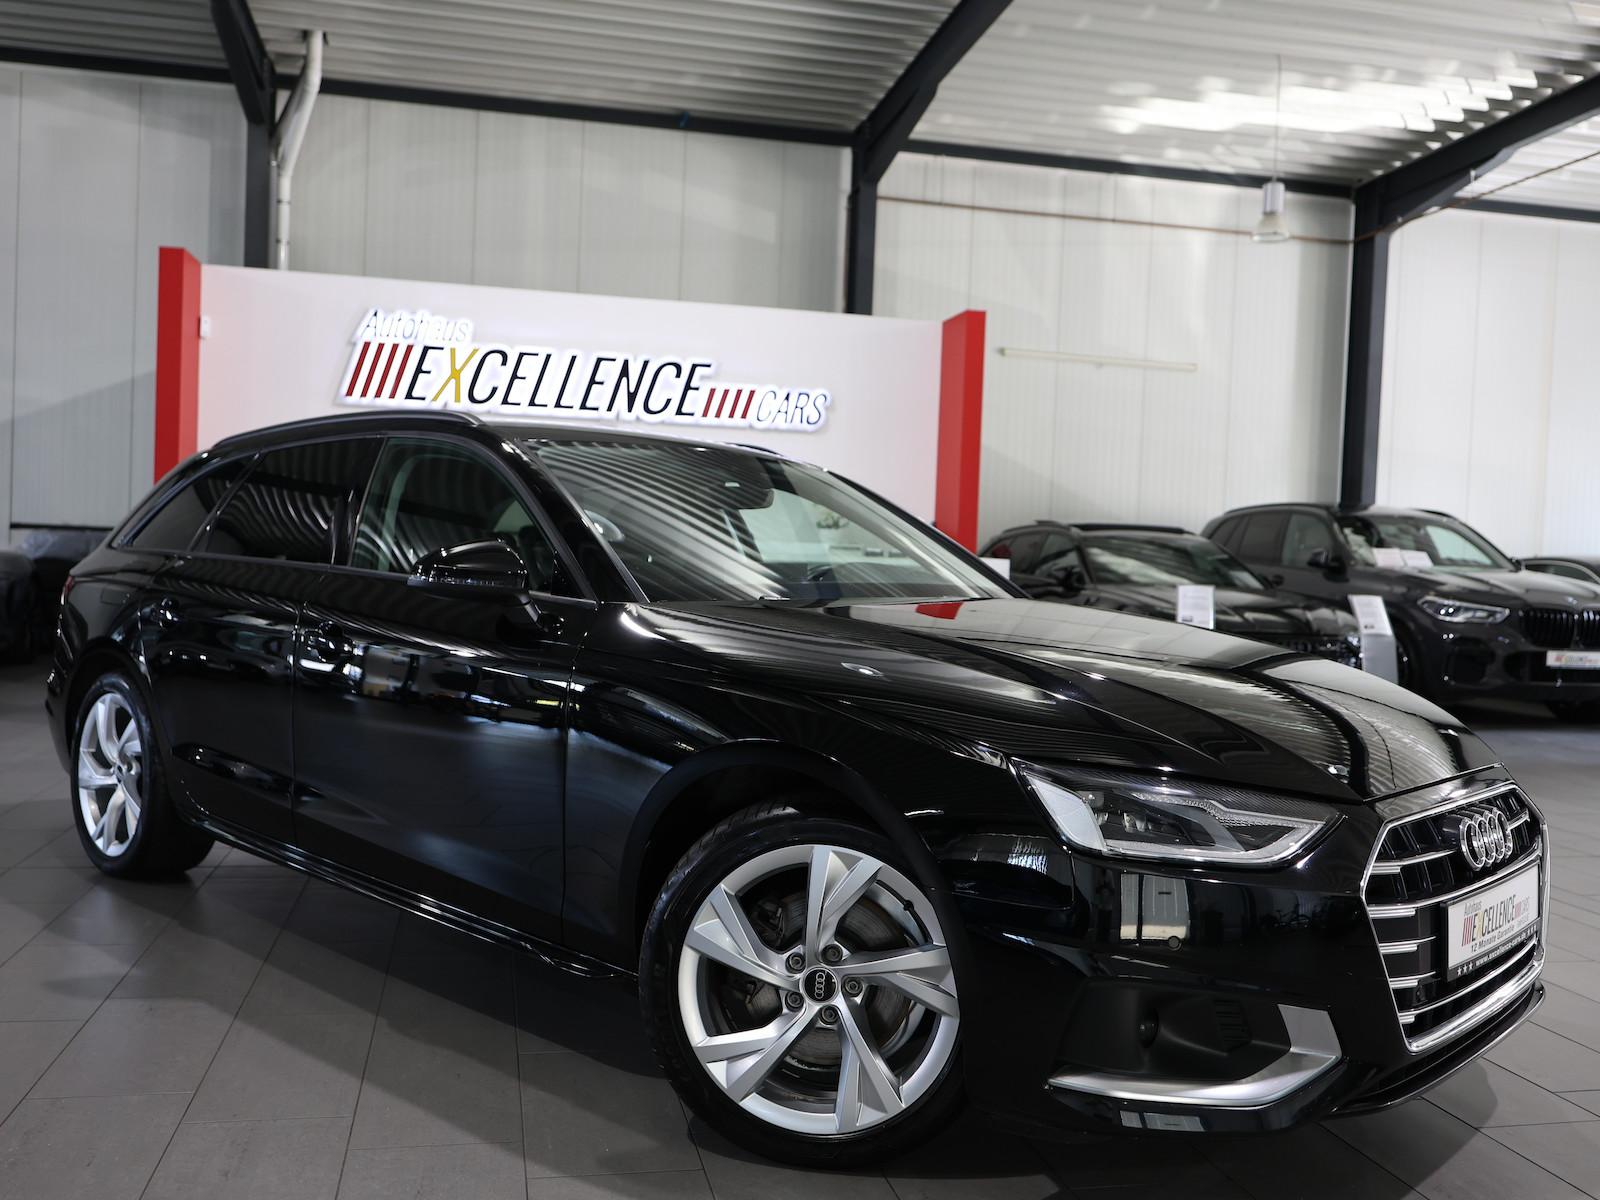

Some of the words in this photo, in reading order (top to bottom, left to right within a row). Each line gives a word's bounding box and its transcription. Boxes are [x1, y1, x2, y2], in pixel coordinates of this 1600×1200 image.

[360, 309, 469, 342] Autohaus
[405, 345, 712, 417] EXCELLENCE
[756, 390, 828, 425] CARS
[1471, 894, 1516, 942] EXCELLENCE
